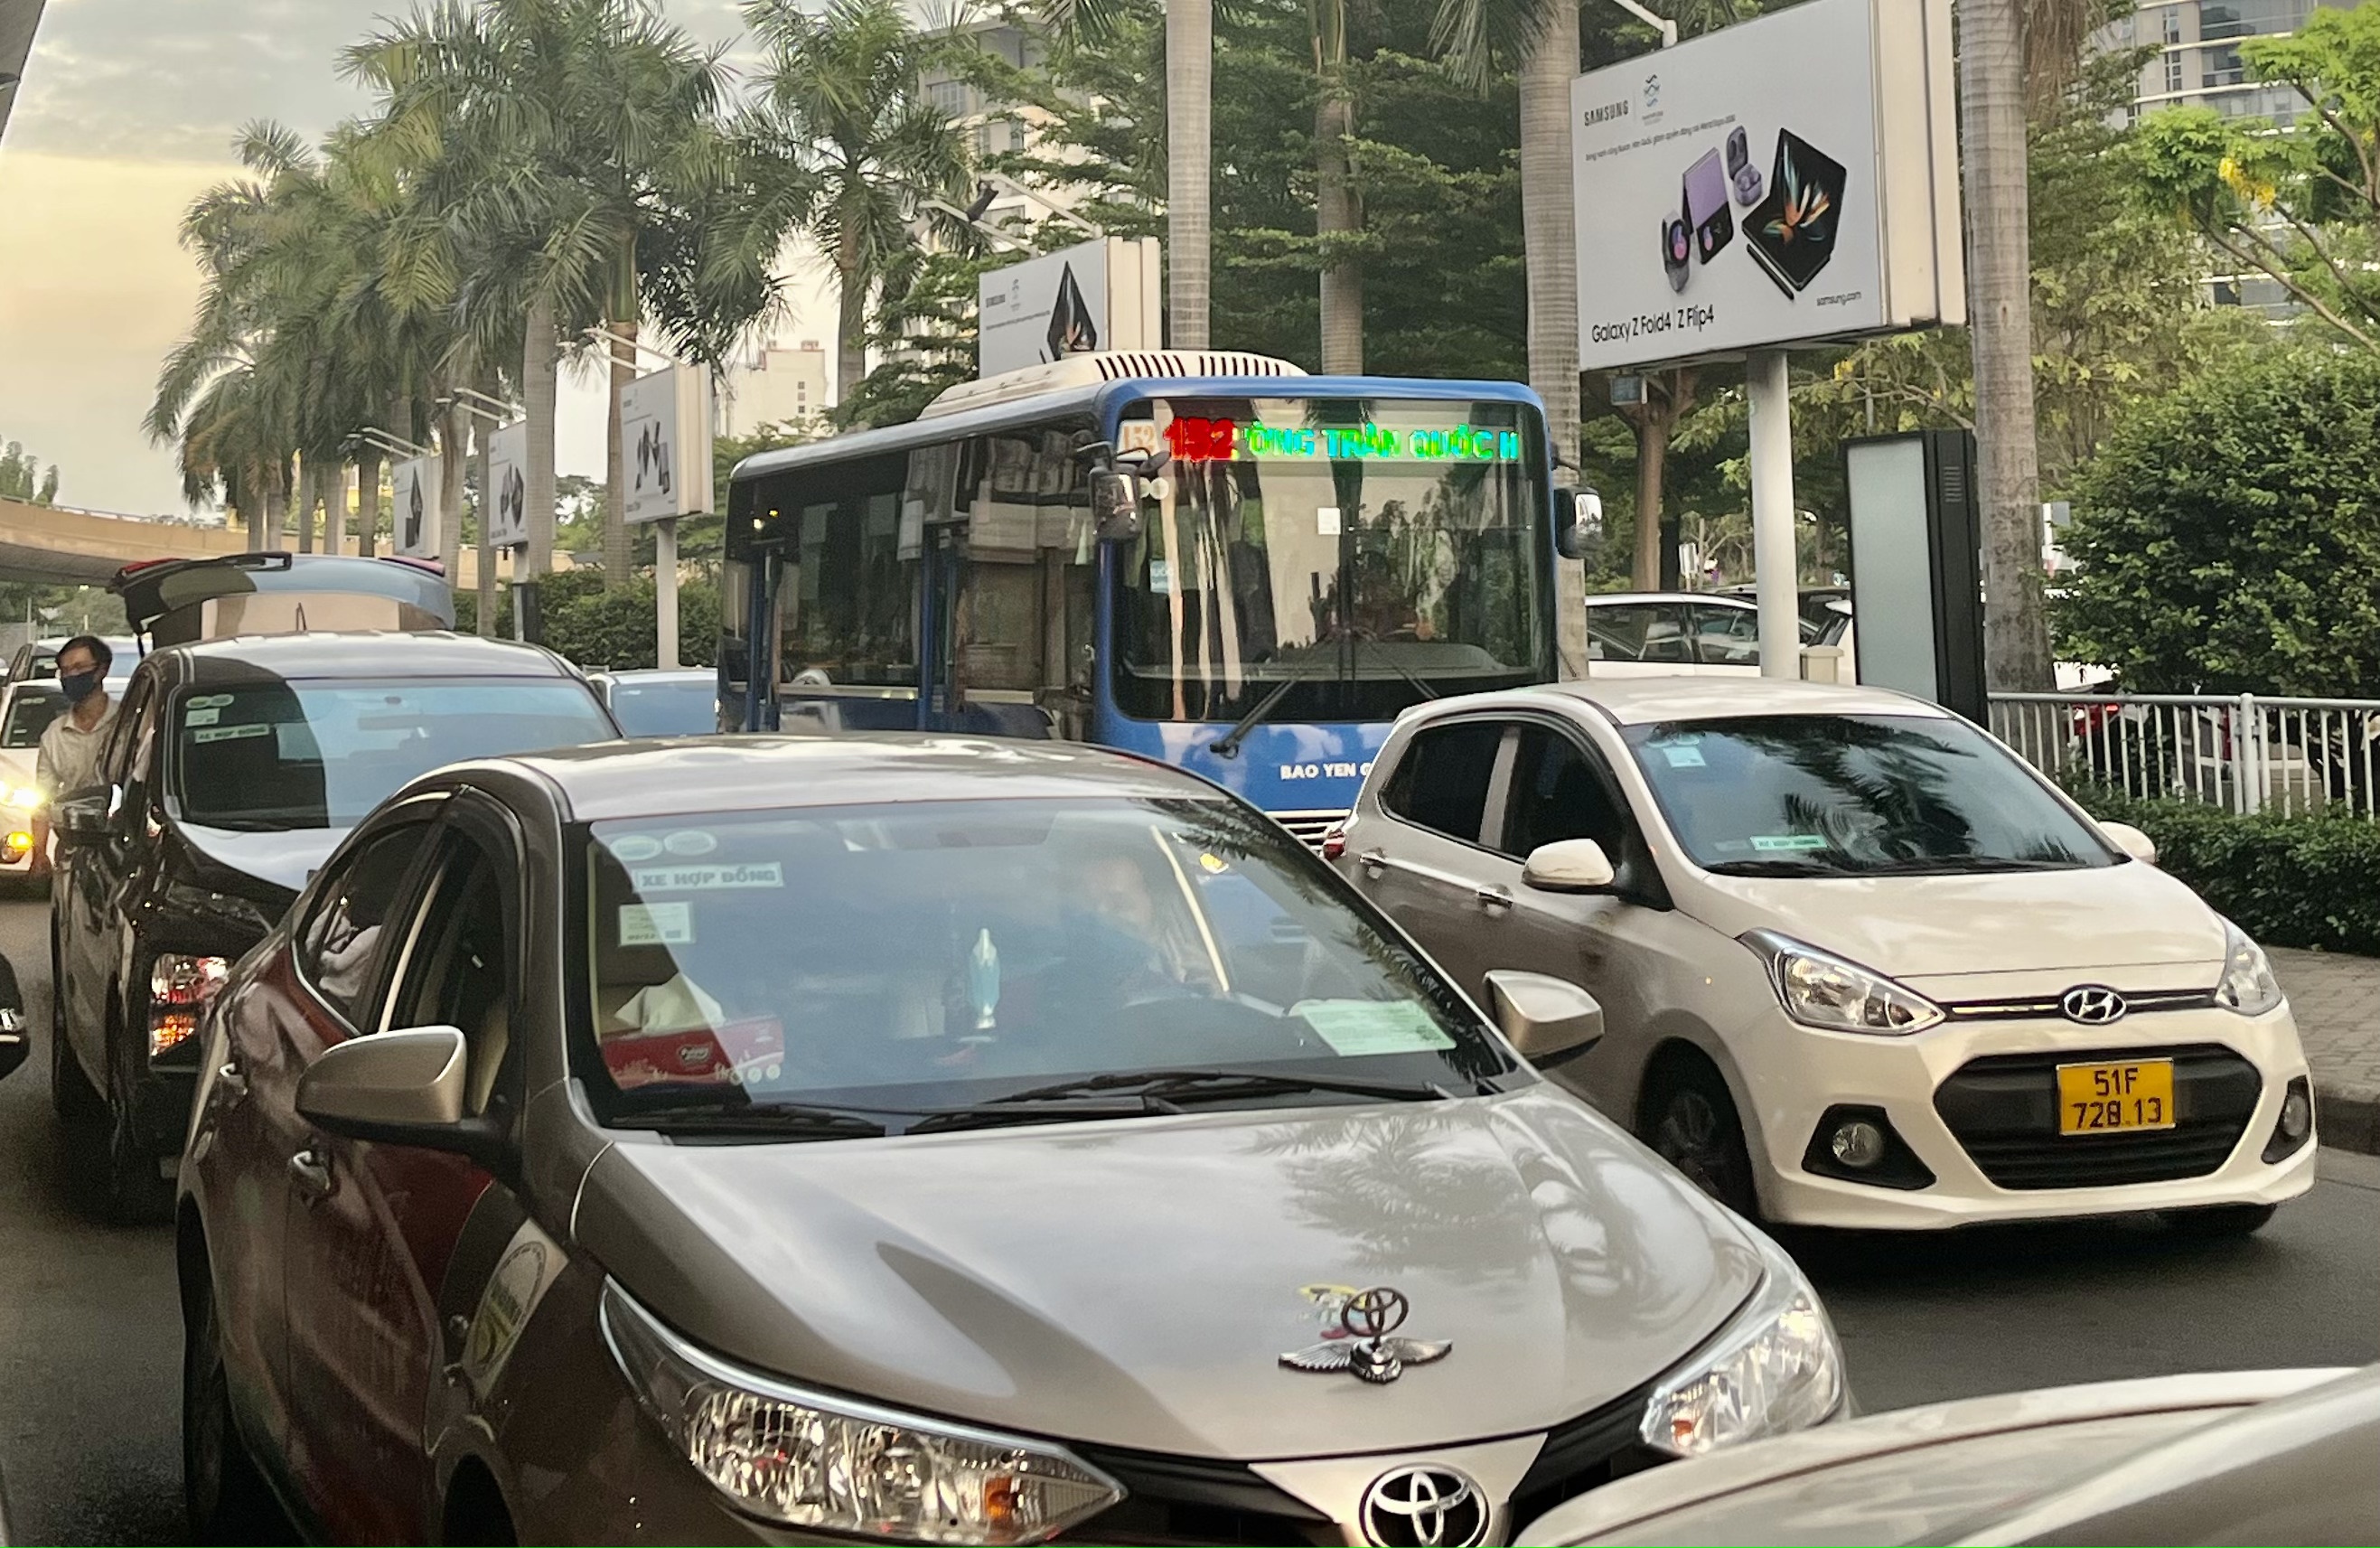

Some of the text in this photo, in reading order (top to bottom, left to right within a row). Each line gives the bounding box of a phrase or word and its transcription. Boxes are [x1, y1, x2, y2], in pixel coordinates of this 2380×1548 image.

[1584, 99, 1629, 127] SAMSUNG
[1816, 291, 1861, 306] samsung.com
[1591, 305, 1715, 342] Galaxy Z Fold4 Z Flip4
[1279, 764, 1319, 780] BAO
[1323, 763, 1356, 778] YEN
[642, 872, 667, 887] XE
[2094, 1067, 2138, 1096] 51F
[2071, 1097, 2162, 1131] 728.13
